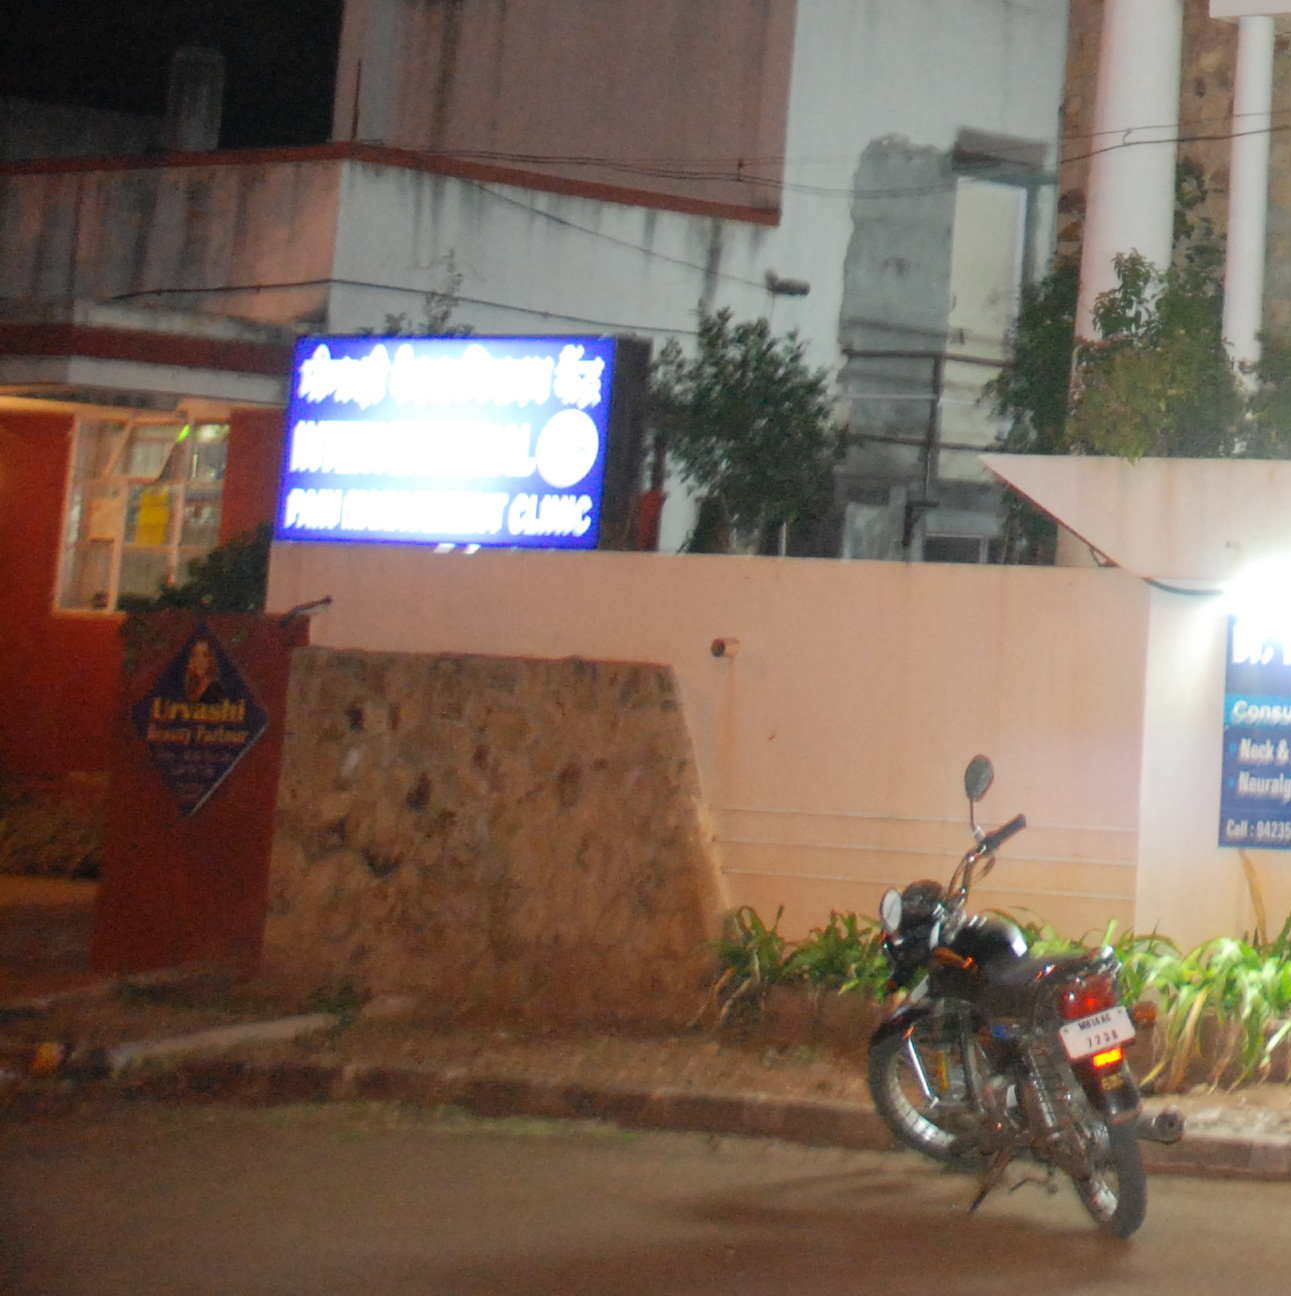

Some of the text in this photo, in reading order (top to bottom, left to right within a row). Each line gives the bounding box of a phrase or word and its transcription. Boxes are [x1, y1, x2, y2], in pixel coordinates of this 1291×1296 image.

[1239, 737, 1274, 763] Neck
[1276, 740, 1289, 763] &
[1226, 819, 1249, 838] Call
